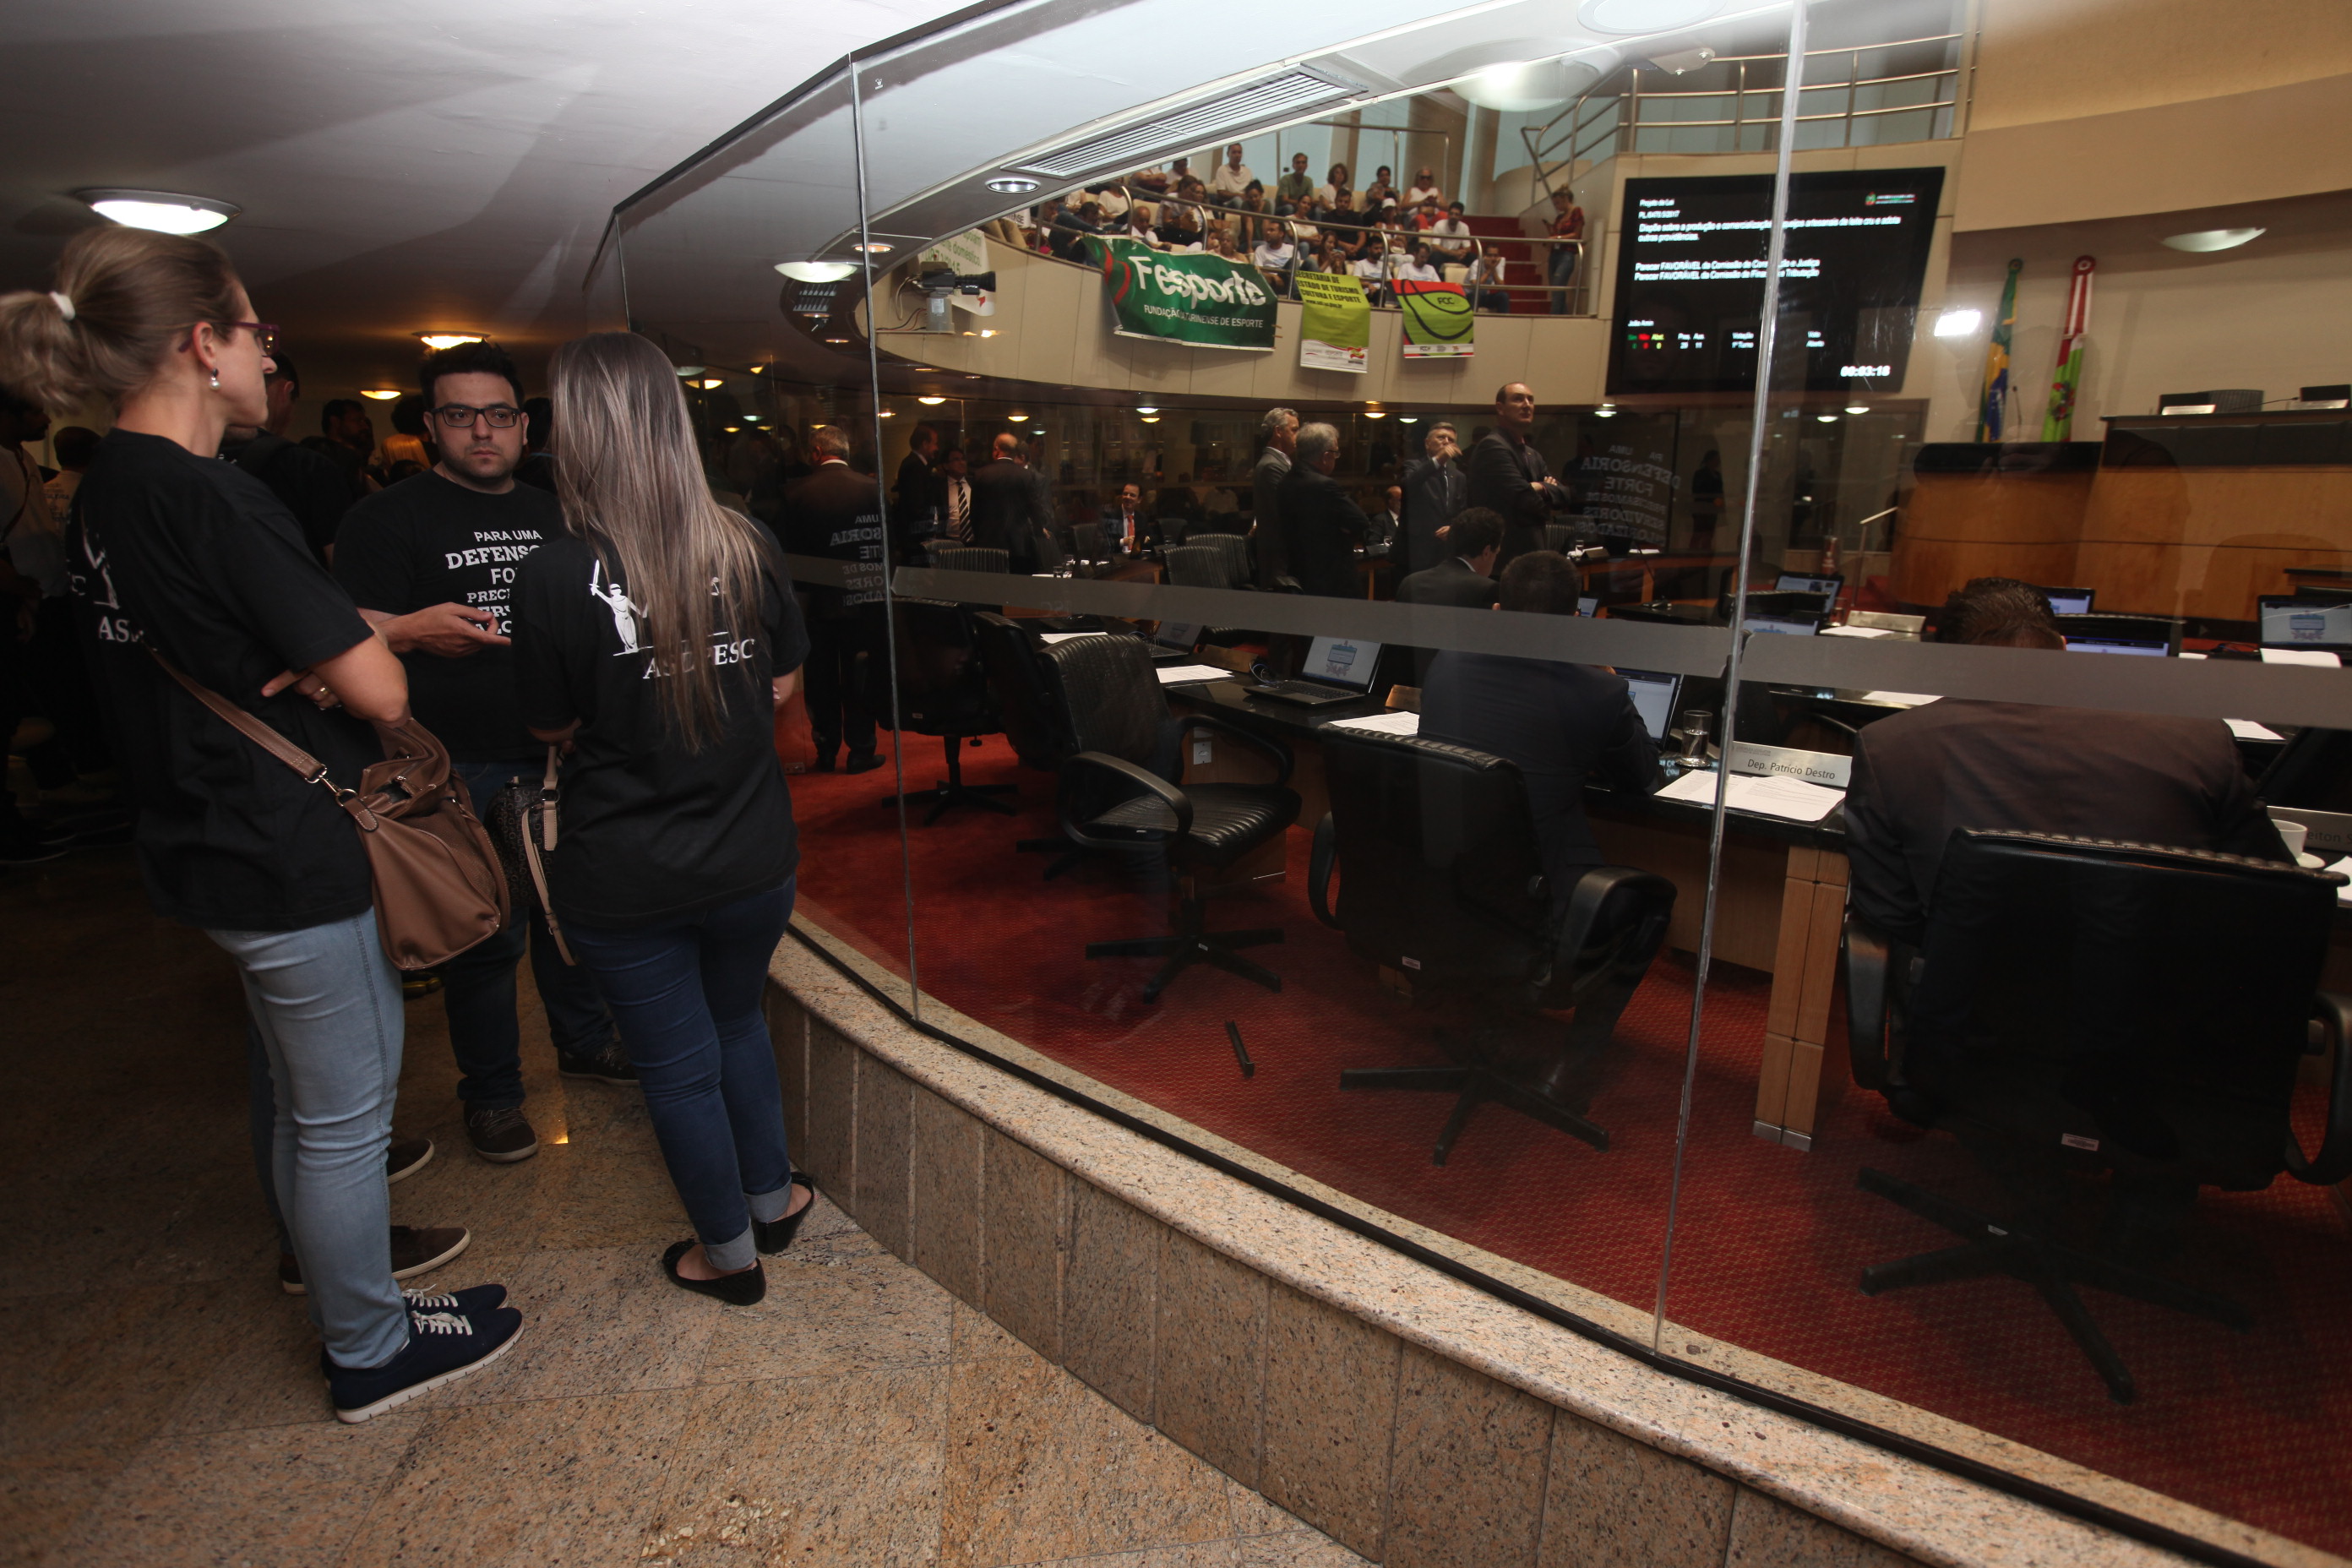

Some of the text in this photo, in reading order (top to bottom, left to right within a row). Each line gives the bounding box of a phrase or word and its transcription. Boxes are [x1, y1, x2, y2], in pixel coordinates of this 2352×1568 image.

[1636, 263, 1660, 271] Parecer
[1128, 255, 1266, 309] Fesporte
[1634, 272, 1659, 280] Parecer
[1298, 280, 1320, 291] ESTADO
[1301, 289, 1328, 300] CULTURA
[1333, 294, 1362, 303] ESPORTE
[1220, 317, 1230, 326] DE
[1231, 318, 1264, 328] ESPORTE
[474, 530, 542, 542] PARA UMA
[491, 567, 518, 585] FO
[1747, 759, 1836, 780] Dep. Patrício Destro
